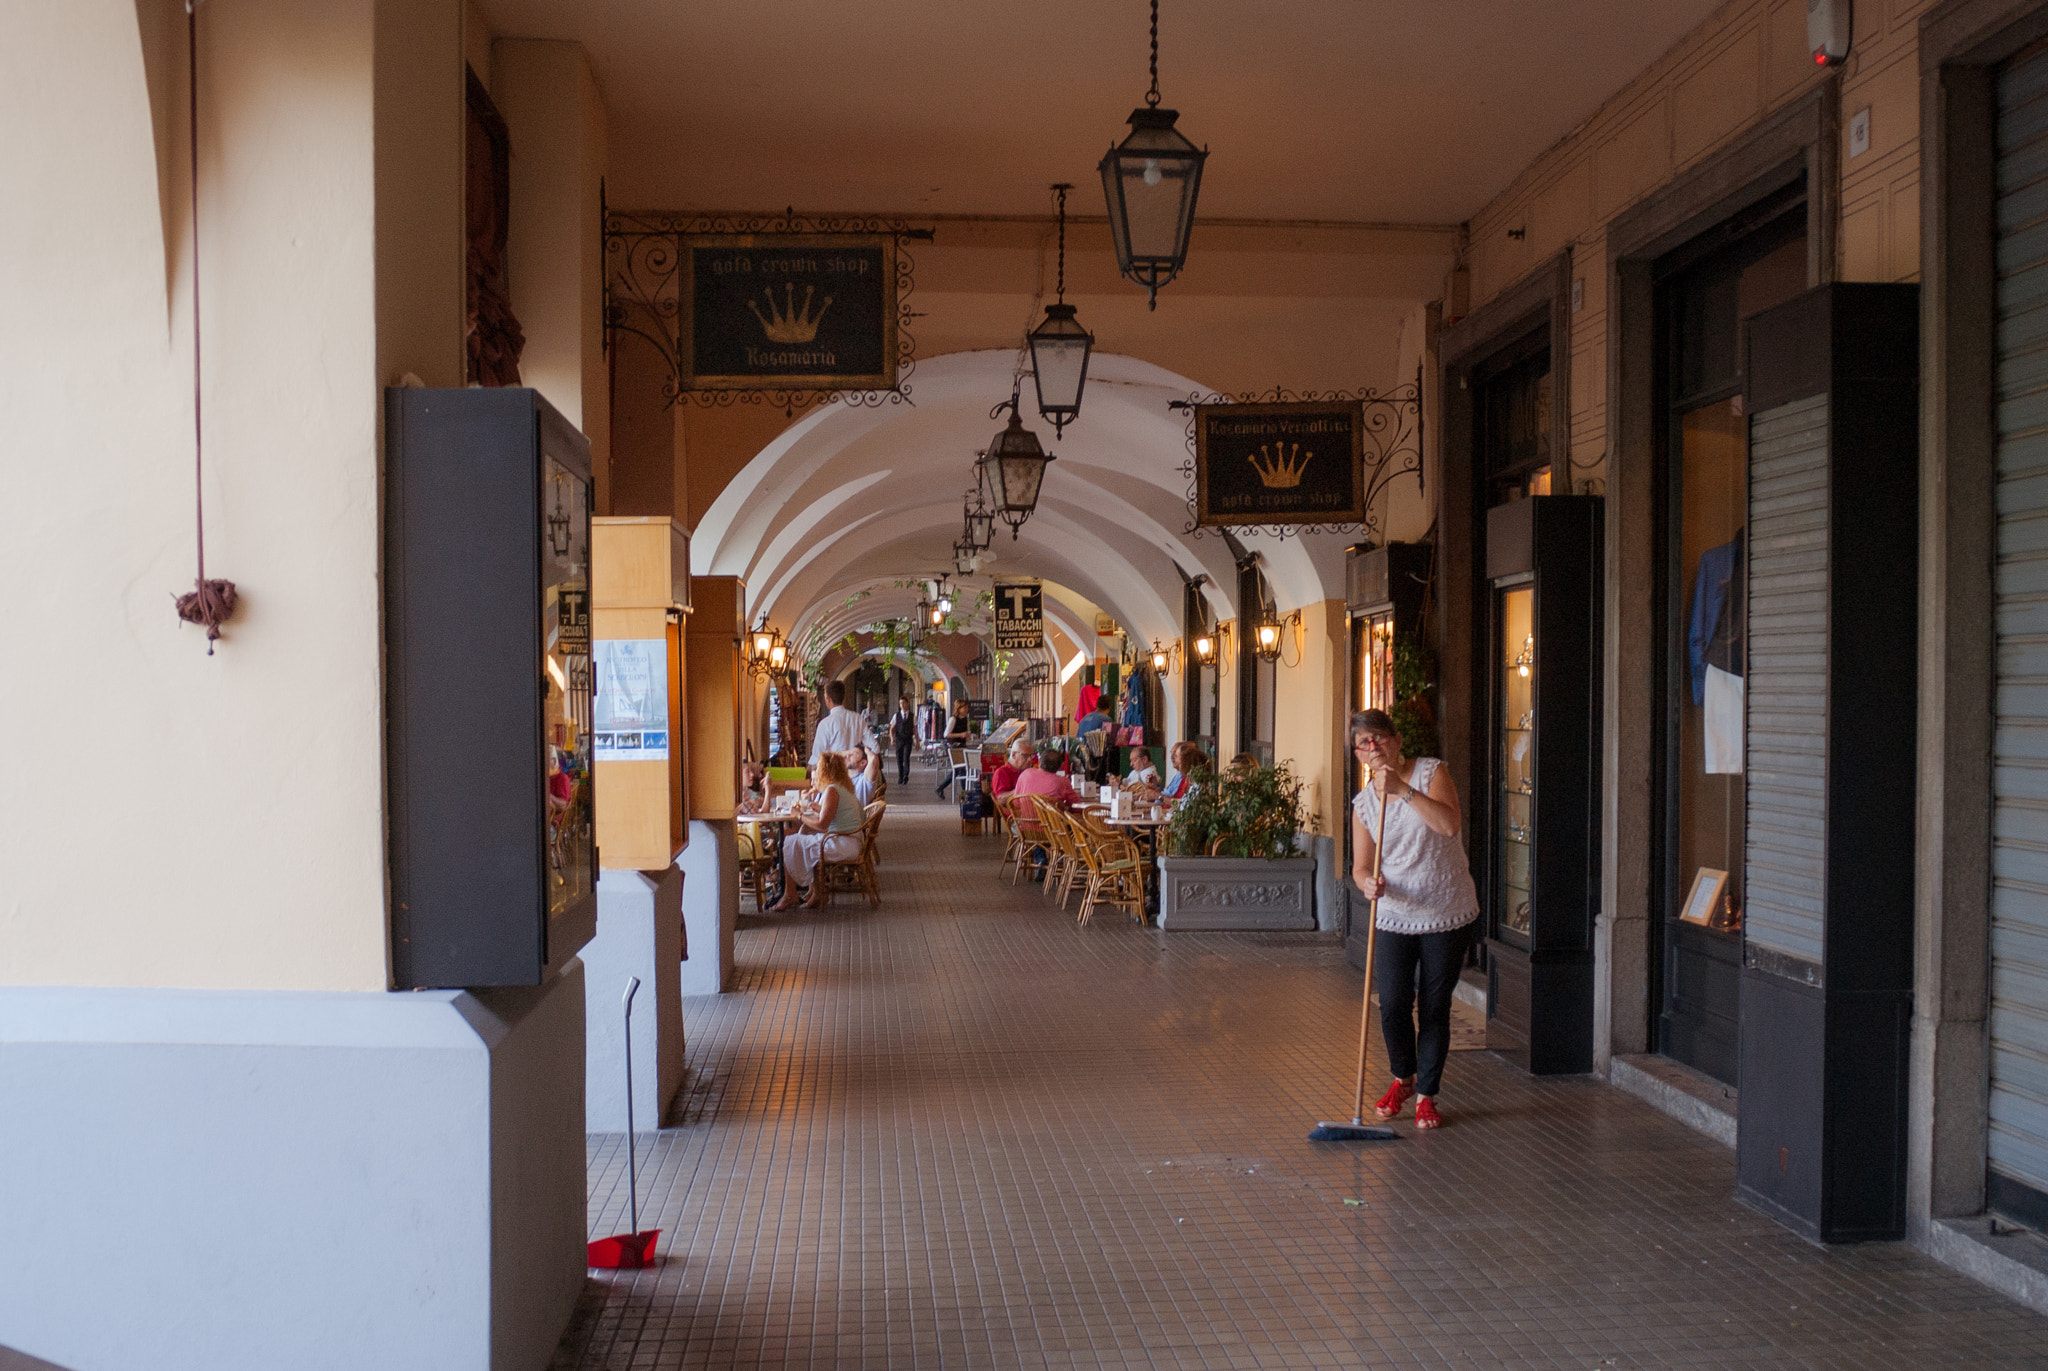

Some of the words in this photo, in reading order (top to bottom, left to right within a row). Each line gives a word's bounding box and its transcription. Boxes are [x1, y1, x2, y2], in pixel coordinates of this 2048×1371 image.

[713, 256, 752, 275] gold
[761, 257, 818, 273] crown
[827, 256, 869, 275] shop
[746, 345, 836, 366] Rosamaria
[1005, 588, 1031, 619] T
[997, 619, 1042, 631] TABACCHI
[998, 638, 1035, 648] LOTTO
